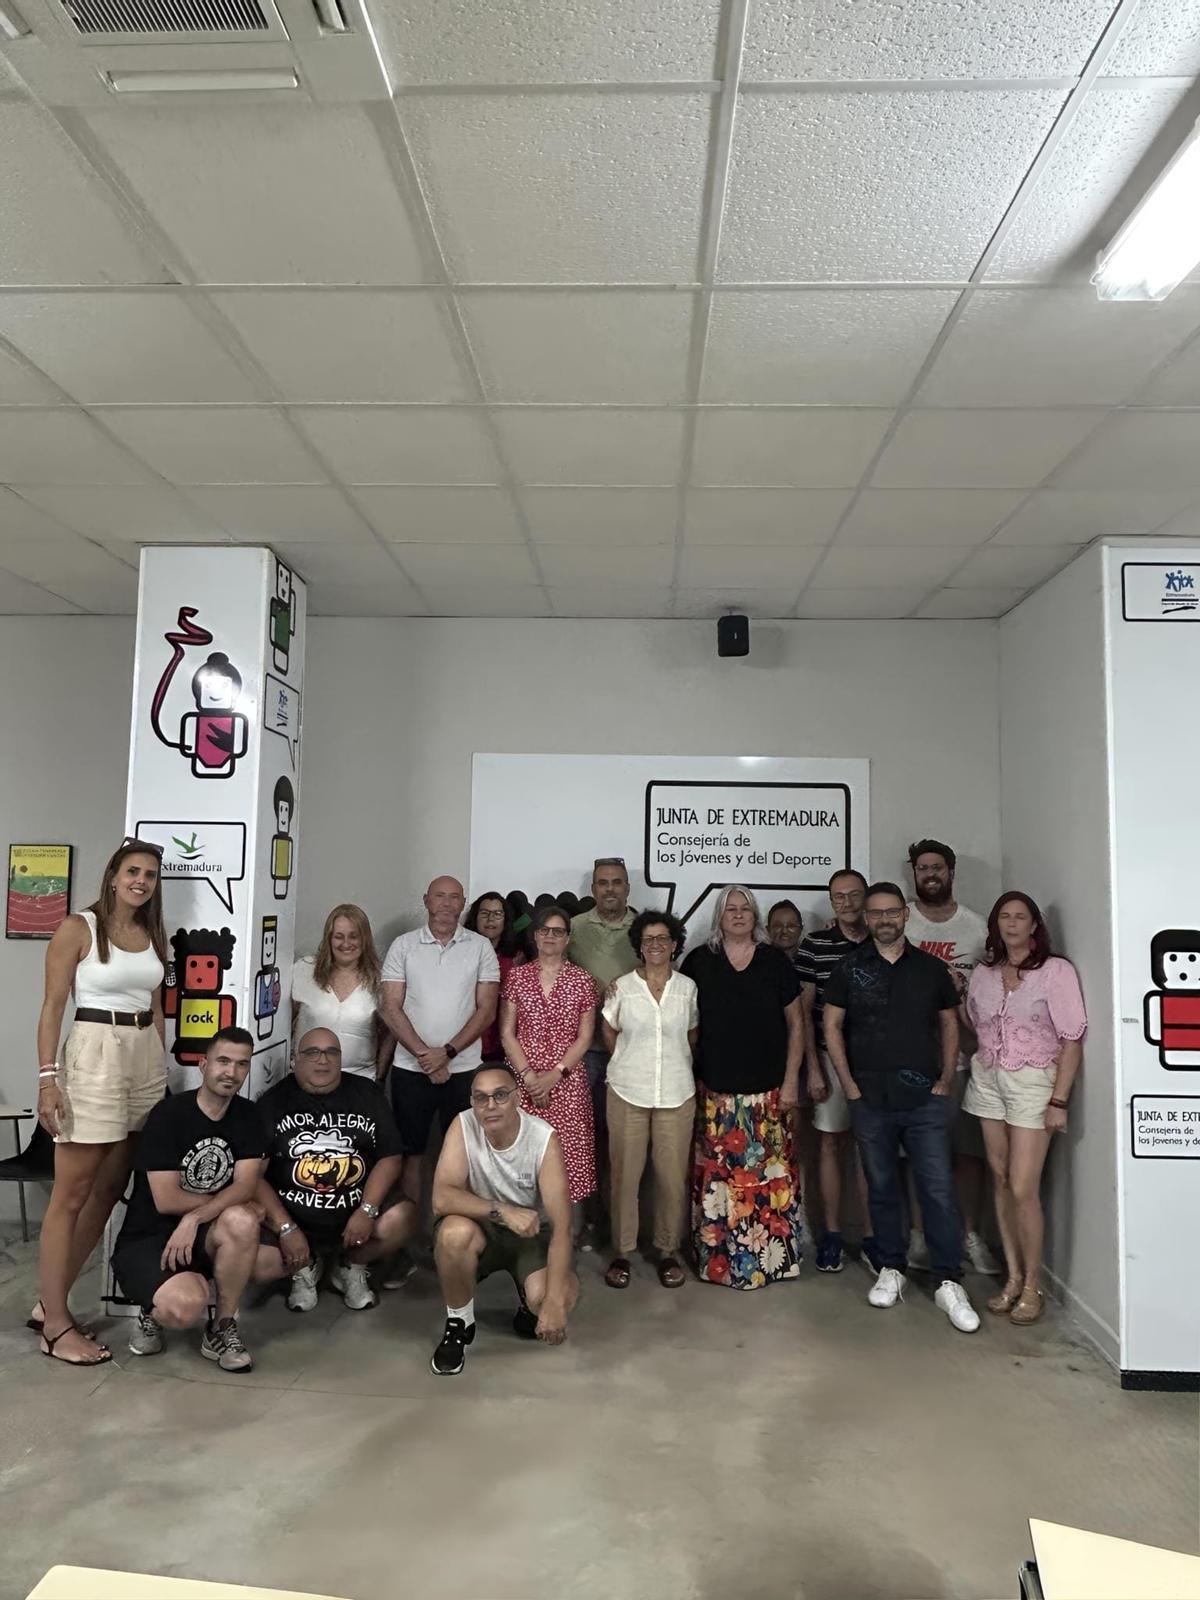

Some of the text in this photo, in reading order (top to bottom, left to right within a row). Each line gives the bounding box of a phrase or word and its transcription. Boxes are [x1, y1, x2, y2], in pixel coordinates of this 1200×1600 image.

[656, 808, 840, 827] JUNTA DE EXTREMADURA
[657, 832, 751, 849] Consejería de
[657, 850, 832, 869] los Jóvenes y del Deporte
[161, 862, 222, 872] xtremadura
[919, 940, 957, 961] NIKE
[186, 1010, 214, 1024] rock
[1137, 1110, 1200, 1123] JUNTA DE EXT
[1184, 1126, 1194, 1135] de
[1138, 1136, 1150, 1145] los
[1184, 1138, 1190, 1147] y
